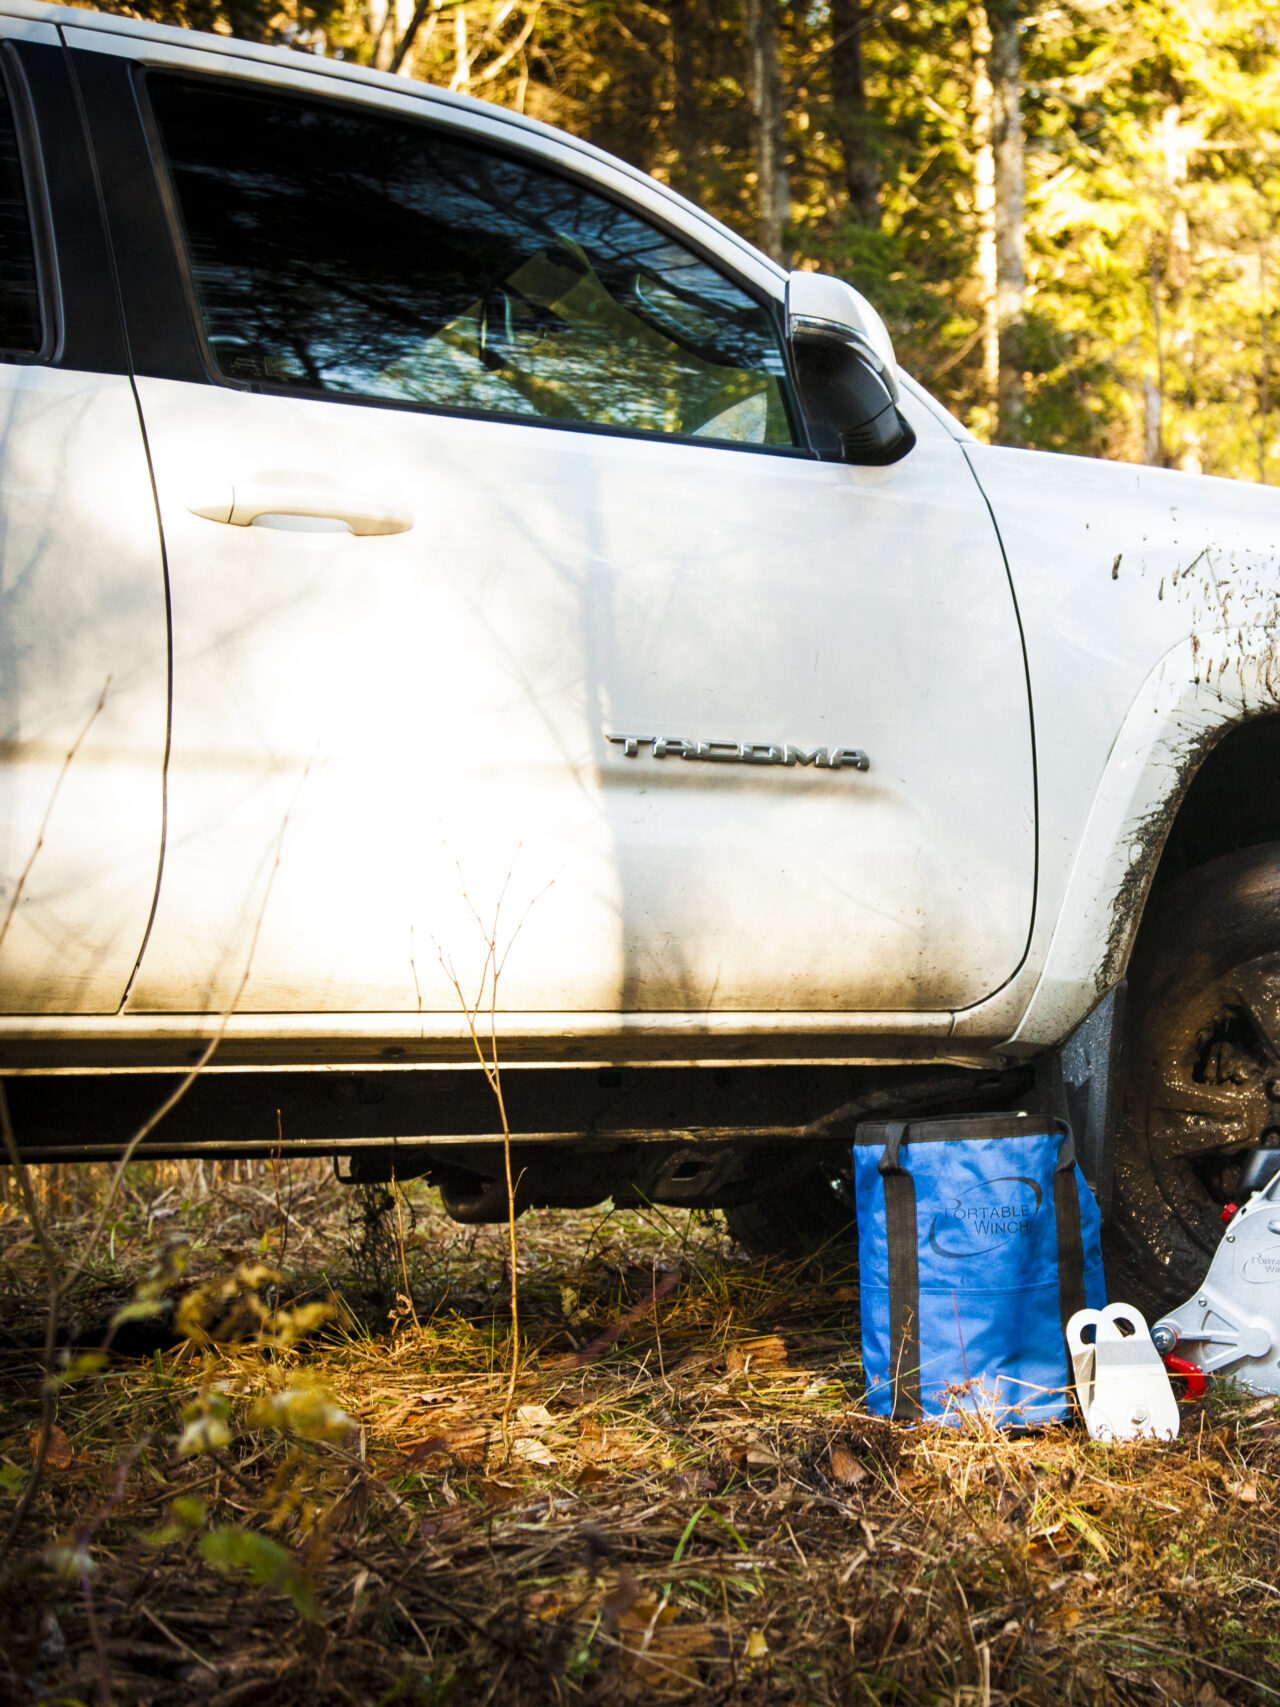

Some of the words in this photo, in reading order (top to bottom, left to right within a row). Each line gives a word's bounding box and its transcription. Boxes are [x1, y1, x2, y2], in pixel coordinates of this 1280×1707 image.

[606, 734, 870, 771] TACOMA
[944, 1199, 1030, 1220] PORTABLE
[974, 1220, 1030, 1235] WINCH
